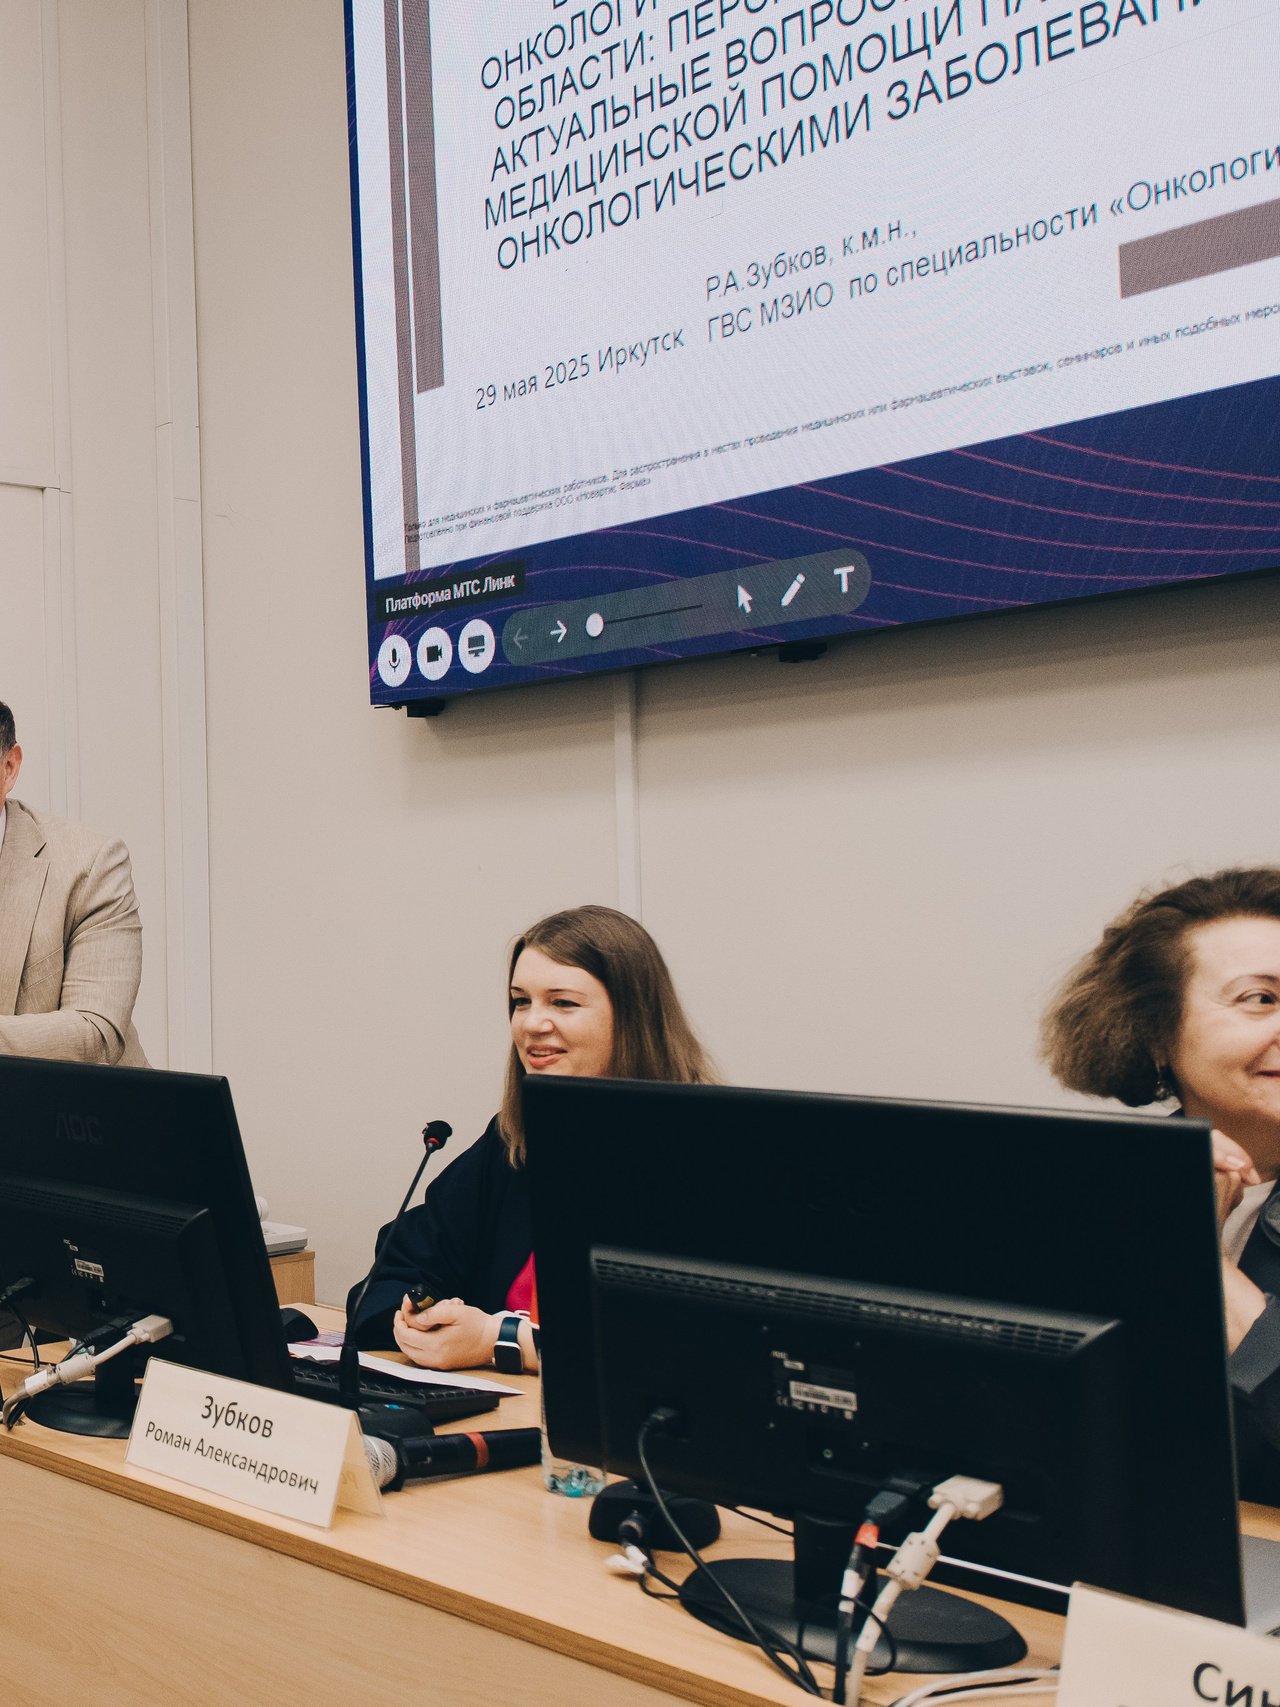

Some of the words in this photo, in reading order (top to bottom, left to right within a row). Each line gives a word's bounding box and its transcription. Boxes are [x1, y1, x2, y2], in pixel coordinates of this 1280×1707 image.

[484, 81, 746, 230] МЕДИЦИНСКОЙ
[761, 0, 963, 117] ПОМОЩИ
[491, 51, 712, 182] АКТУАЛЬНЫЕ
[494, 30, 654, 129] ОБЛАСТИ:
[668, 0, 777, 53] ПЕР
[497, 93, 871, 269] ОНКОЛОГИЧЕСКИМИ
[886, 0, 1200, 120] ЗАБОЛЕВА
[841, 219, 917, 257] к.м.н.,
[475, 384, 497, 410] 29
[503, 373, 538, 402] мая
[544, 354, 591, 389] 2025
[597, 327, 685, 373] Иркутск
[706, 307, 753, 342] ГВС
[760, 281, 834, 326] МЗИО
[848, 273, 878, 300] по
[886, 203, 1098, 288] специальности
[385, 585, 451, 615] Платформа
[453, 580, 481, 600] МТС
[483, 573, 516, 595] Линк
[145, 1420, 192, 1451] Роман
[193, 1437, 319, 1494] Александрович
[201, 1395, 274, 1438] Зубков
